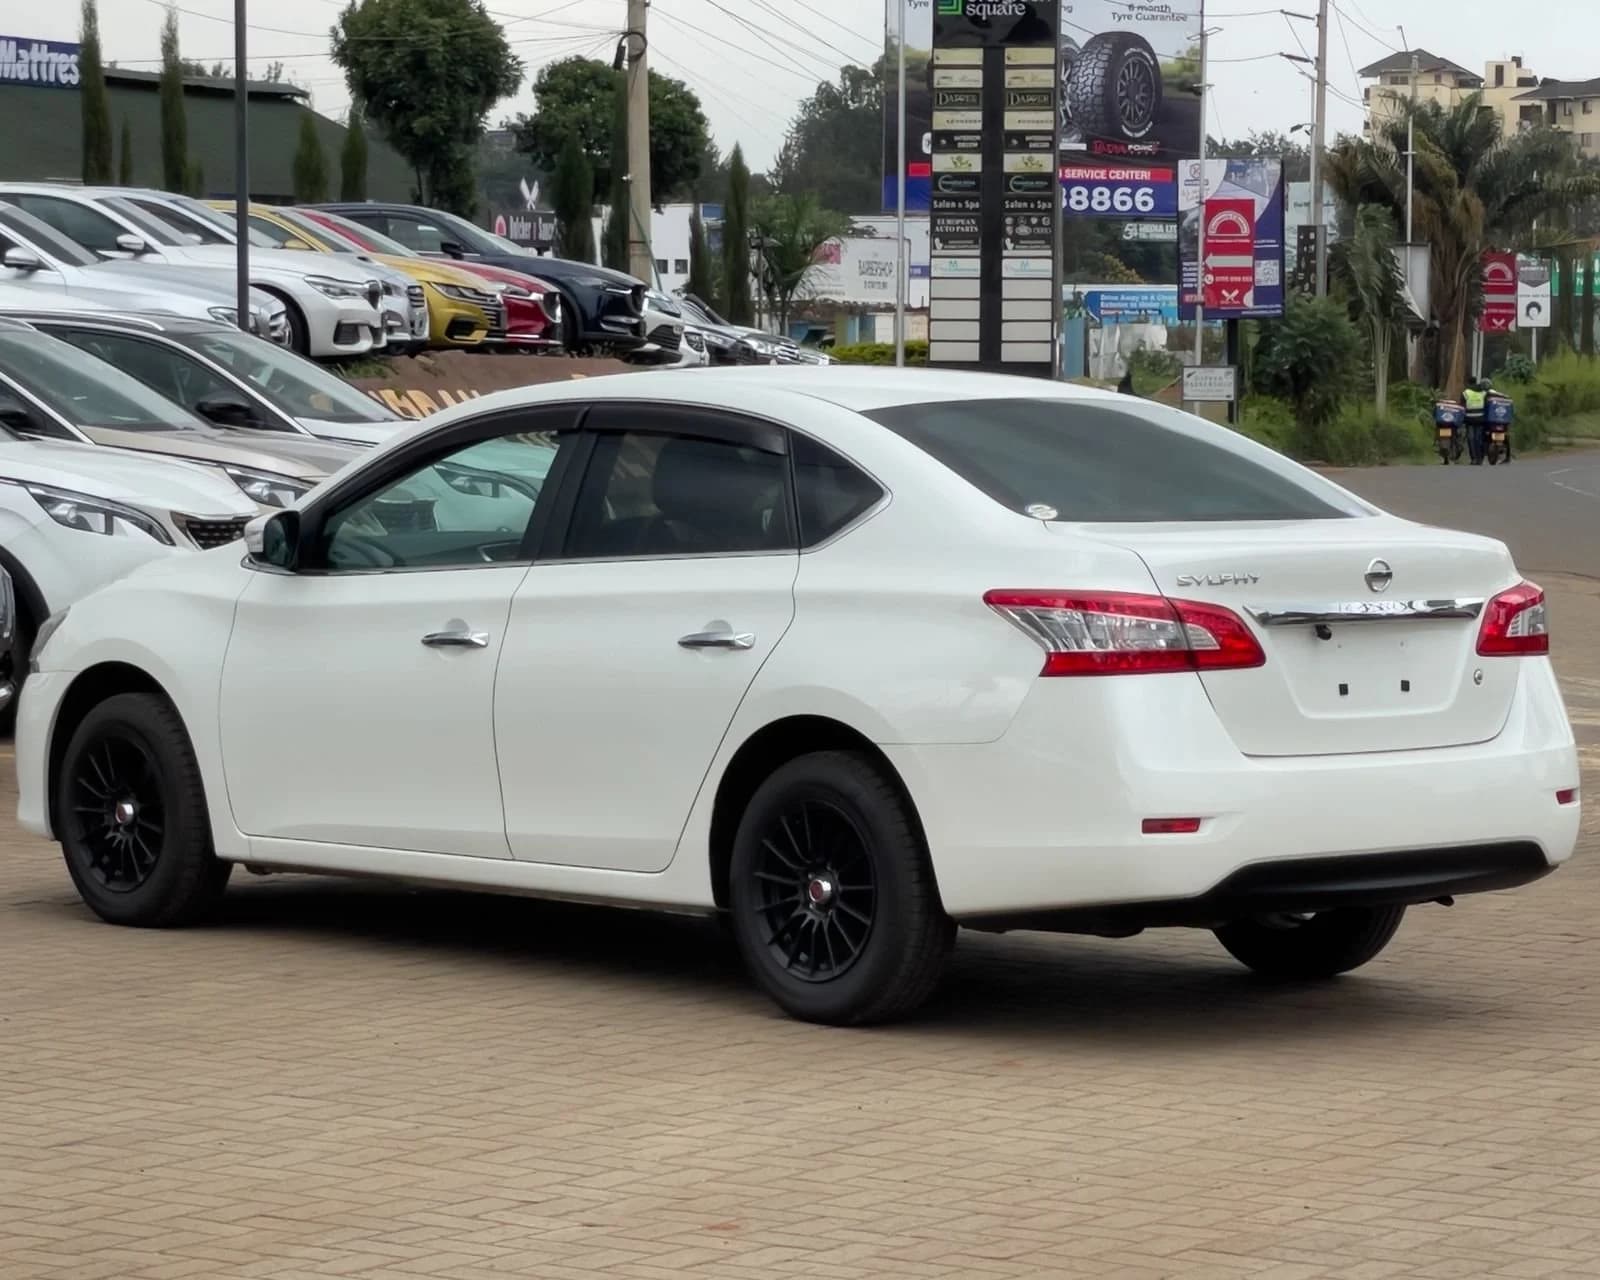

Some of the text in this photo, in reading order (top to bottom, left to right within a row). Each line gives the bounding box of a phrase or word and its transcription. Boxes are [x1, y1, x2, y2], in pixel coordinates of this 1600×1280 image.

[966, 3, 1026, 21] square
[1112, 12, 1188, 22] Tyre Guarantee
[1065, 168, 1151, 180] SERVICE CENTER!
[1177, 572, 1260, 587] SYLPHY
